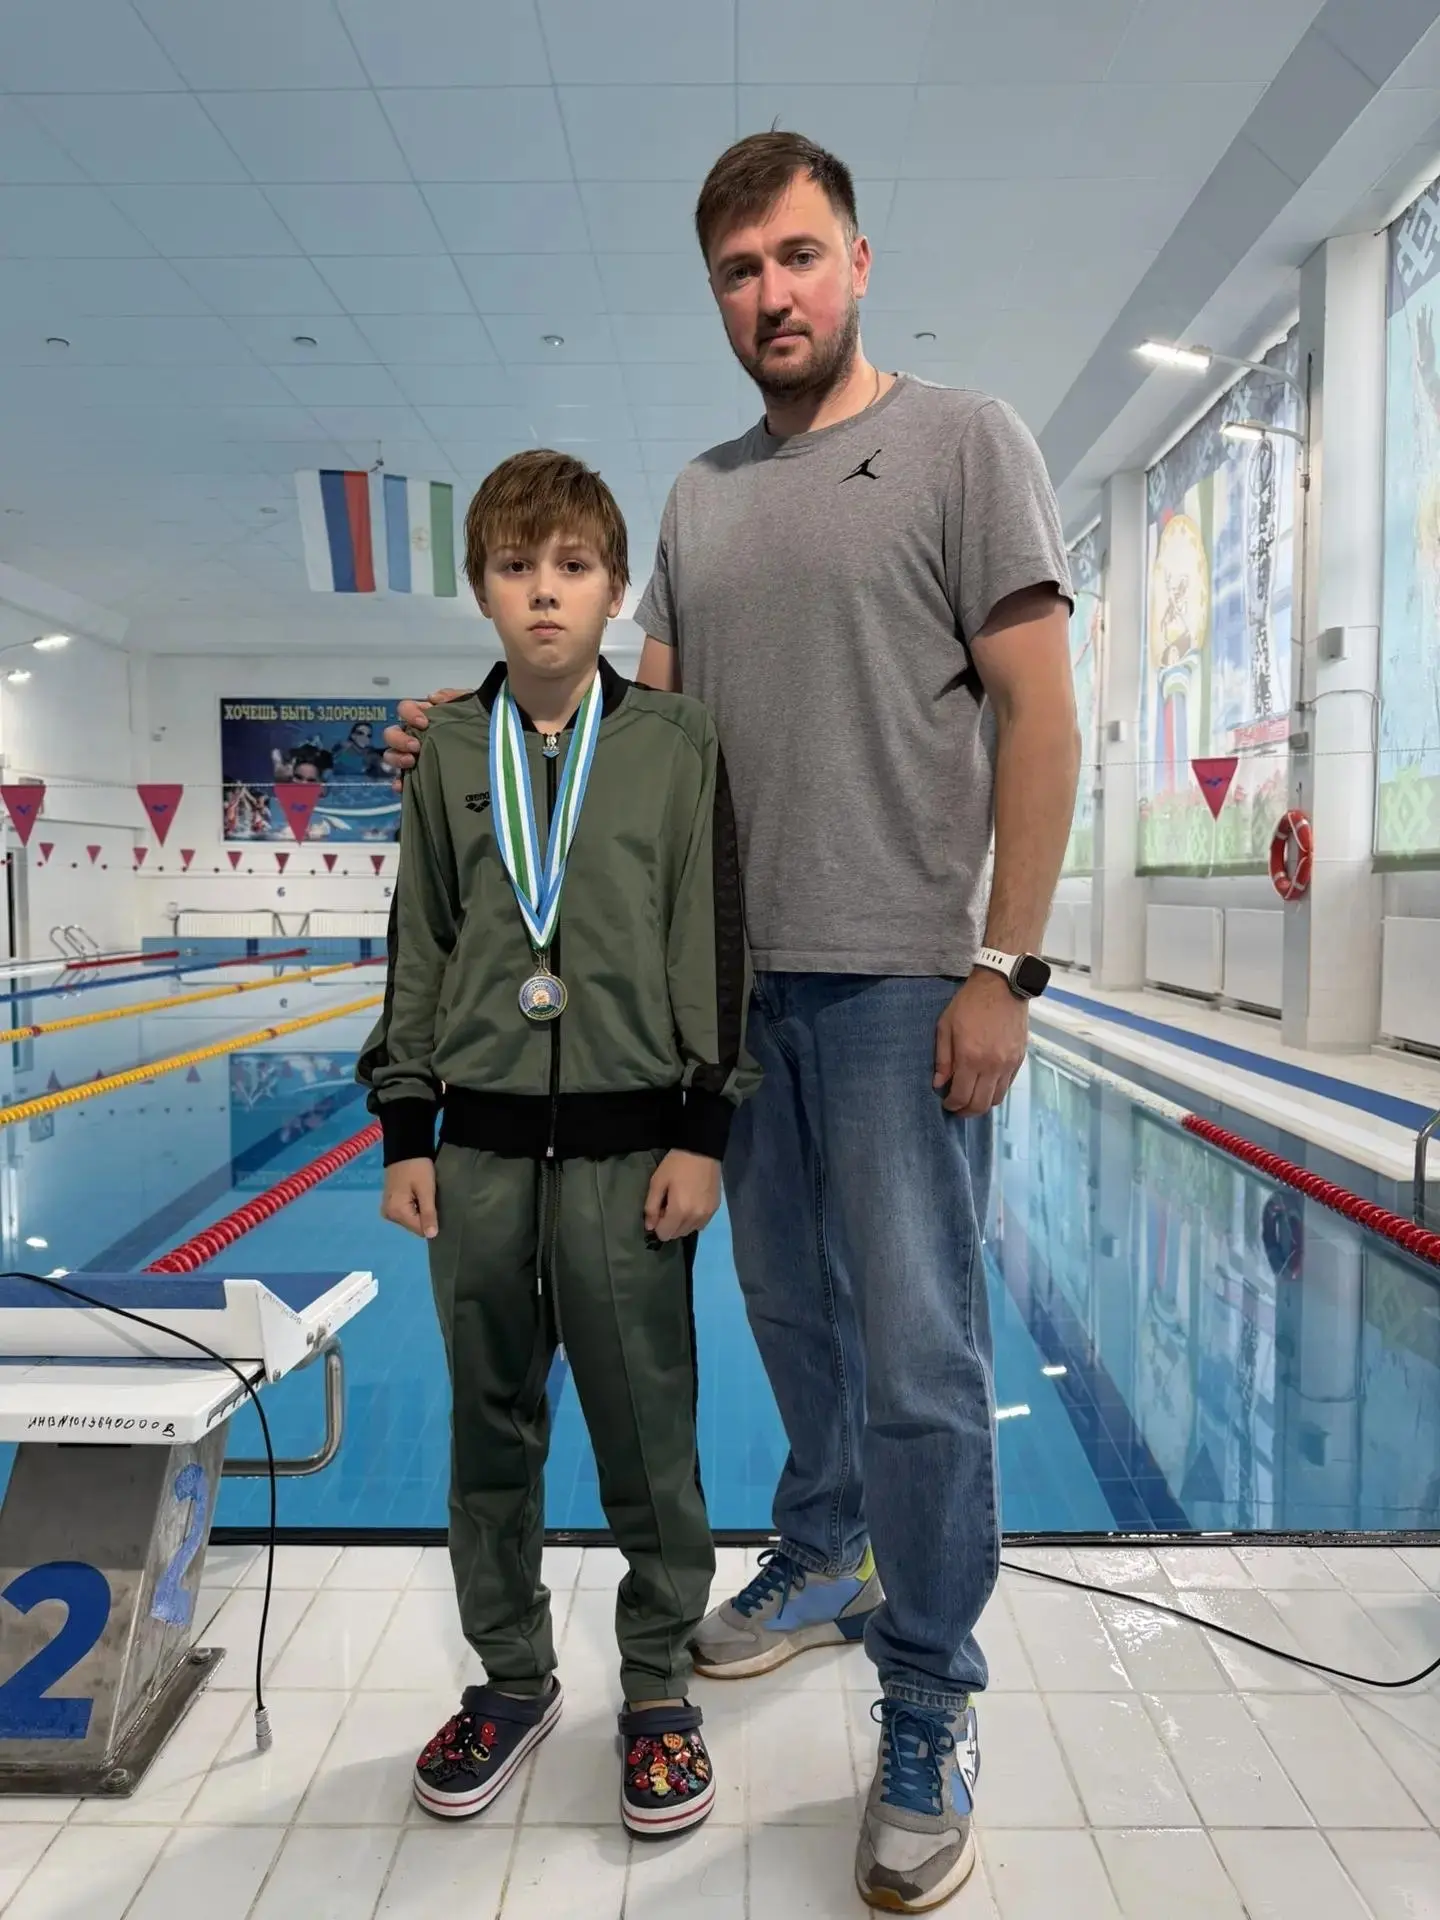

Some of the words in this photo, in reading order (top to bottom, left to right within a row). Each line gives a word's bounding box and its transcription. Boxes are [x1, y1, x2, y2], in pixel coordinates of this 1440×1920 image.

[224, 704, 277, 720] ХОЧЕШЬ
[280, 704, 315, 721] БЫТЬ
[318, 705, 387, 722] ЗДОРОВЫМ
[277, 886, 286, 898] 6
[151, 1463, 209, 1626] 2
[0, 1561, 112, 1739] 2
